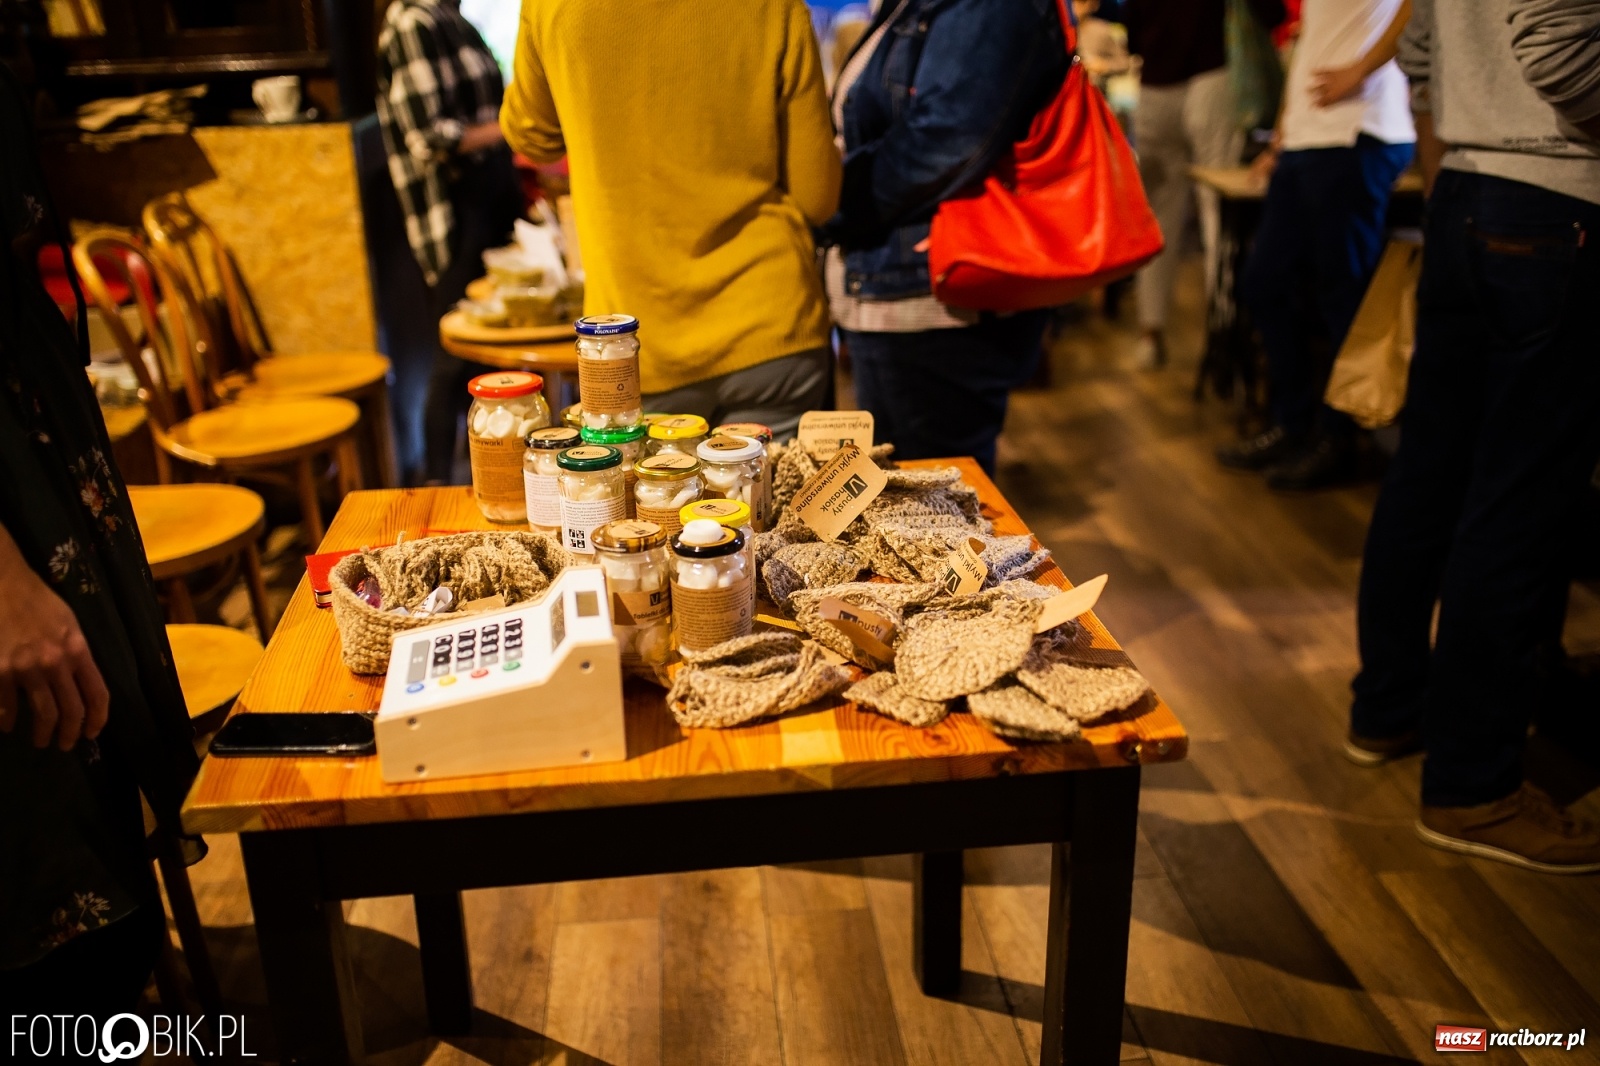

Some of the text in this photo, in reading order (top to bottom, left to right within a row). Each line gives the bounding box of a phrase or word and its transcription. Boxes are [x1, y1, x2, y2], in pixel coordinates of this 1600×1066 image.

[795, 447, 860, 513] Myjki uniwersalne
[820, 486, 846, 513] hasiok
[832, 494, 853, 515] pusty
[963, 559, 982, 581] Myjki
